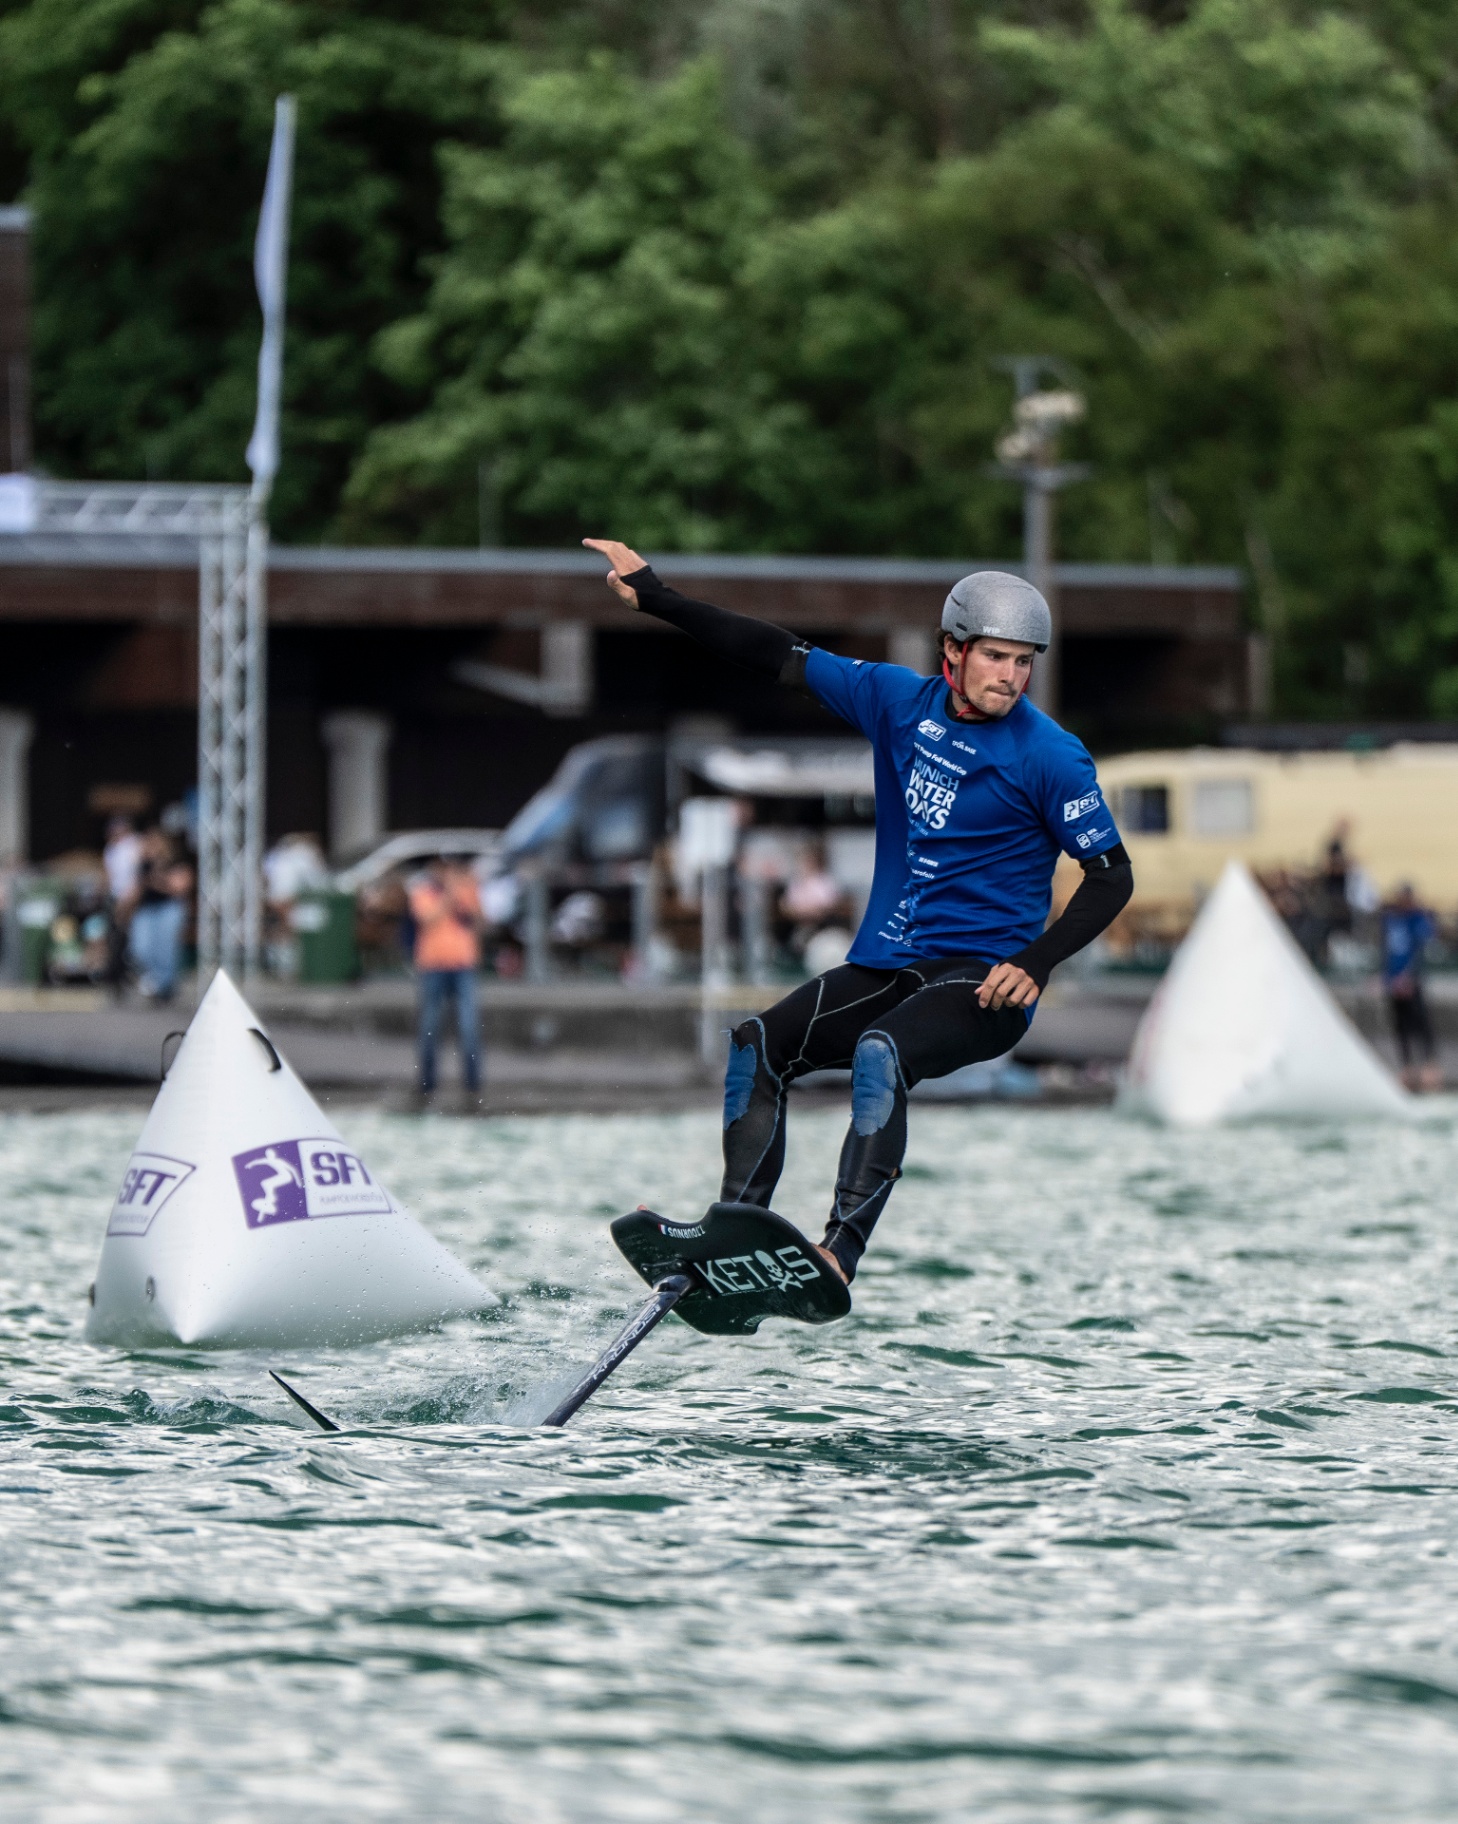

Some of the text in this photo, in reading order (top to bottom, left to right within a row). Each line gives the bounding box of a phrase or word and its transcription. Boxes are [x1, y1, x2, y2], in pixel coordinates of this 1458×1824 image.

[928, 723, 943, 736] SFT
[914, 756, 960, 791] MUNICH
[931, 754, 943, 763] Foil
[942, 759, 957, 771] World
[956, 766, 967, 776] Cup
[909, 768, 956, 810] WATER
[905, 787, 950, 829] DAYS
[310, 1151, 373, 1186] SFT
[118, 1168, 177, 1206] SFT
